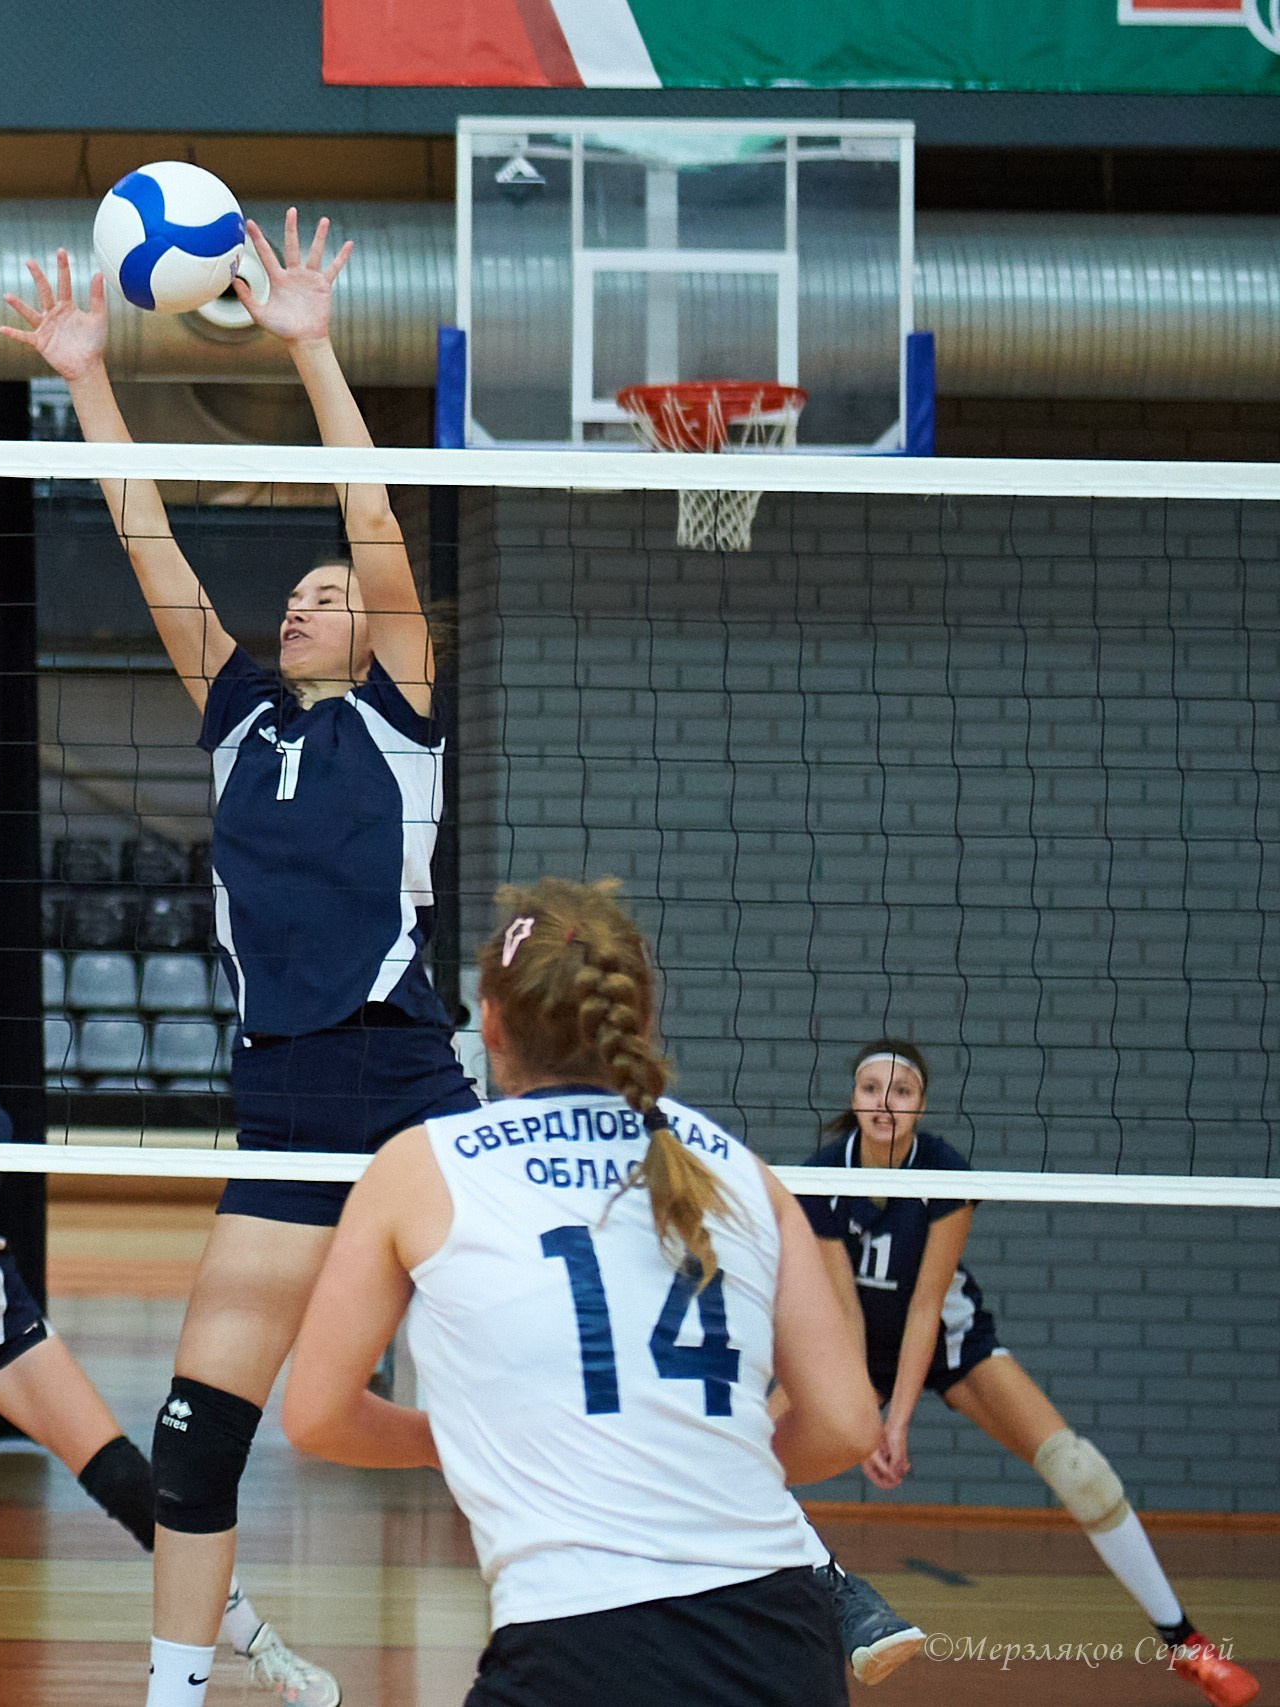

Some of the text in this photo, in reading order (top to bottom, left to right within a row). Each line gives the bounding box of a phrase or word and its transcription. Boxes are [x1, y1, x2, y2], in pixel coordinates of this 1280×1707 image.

[454, 1108, 730, 1160] СВЕРДЛОВКАЯ
[525, 1157, 648, 1190] ОБЛАС
[858, 1231, 893, 1281] 11
[540, 1225, 740, 1417] 14
